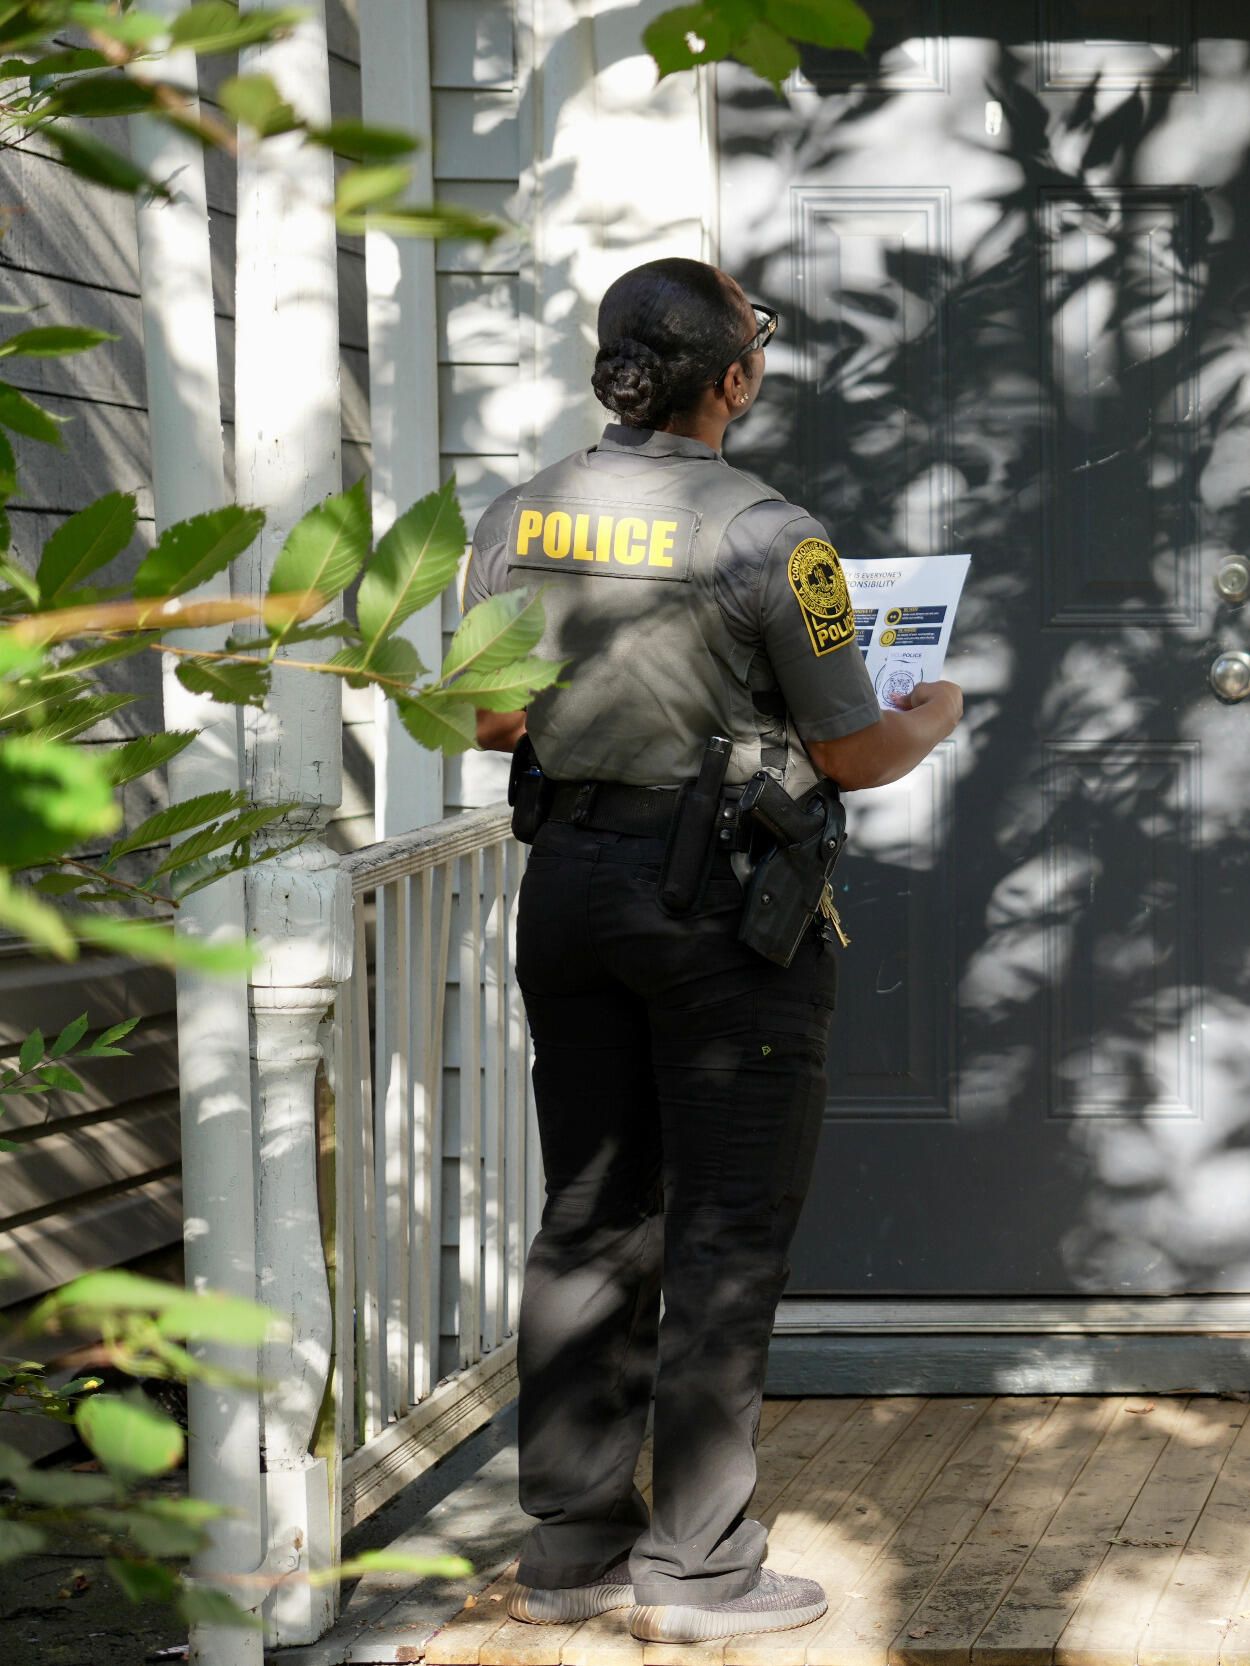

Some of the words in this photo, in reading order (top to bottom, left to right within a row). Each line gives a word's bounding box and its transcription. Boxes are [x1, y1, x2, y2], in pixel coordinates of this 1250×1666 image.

[516, 510, 677, 568] POLICE
[846, 579, 896, 589] ONSIBILITY
[816, 614, 855, 647] POLIC
